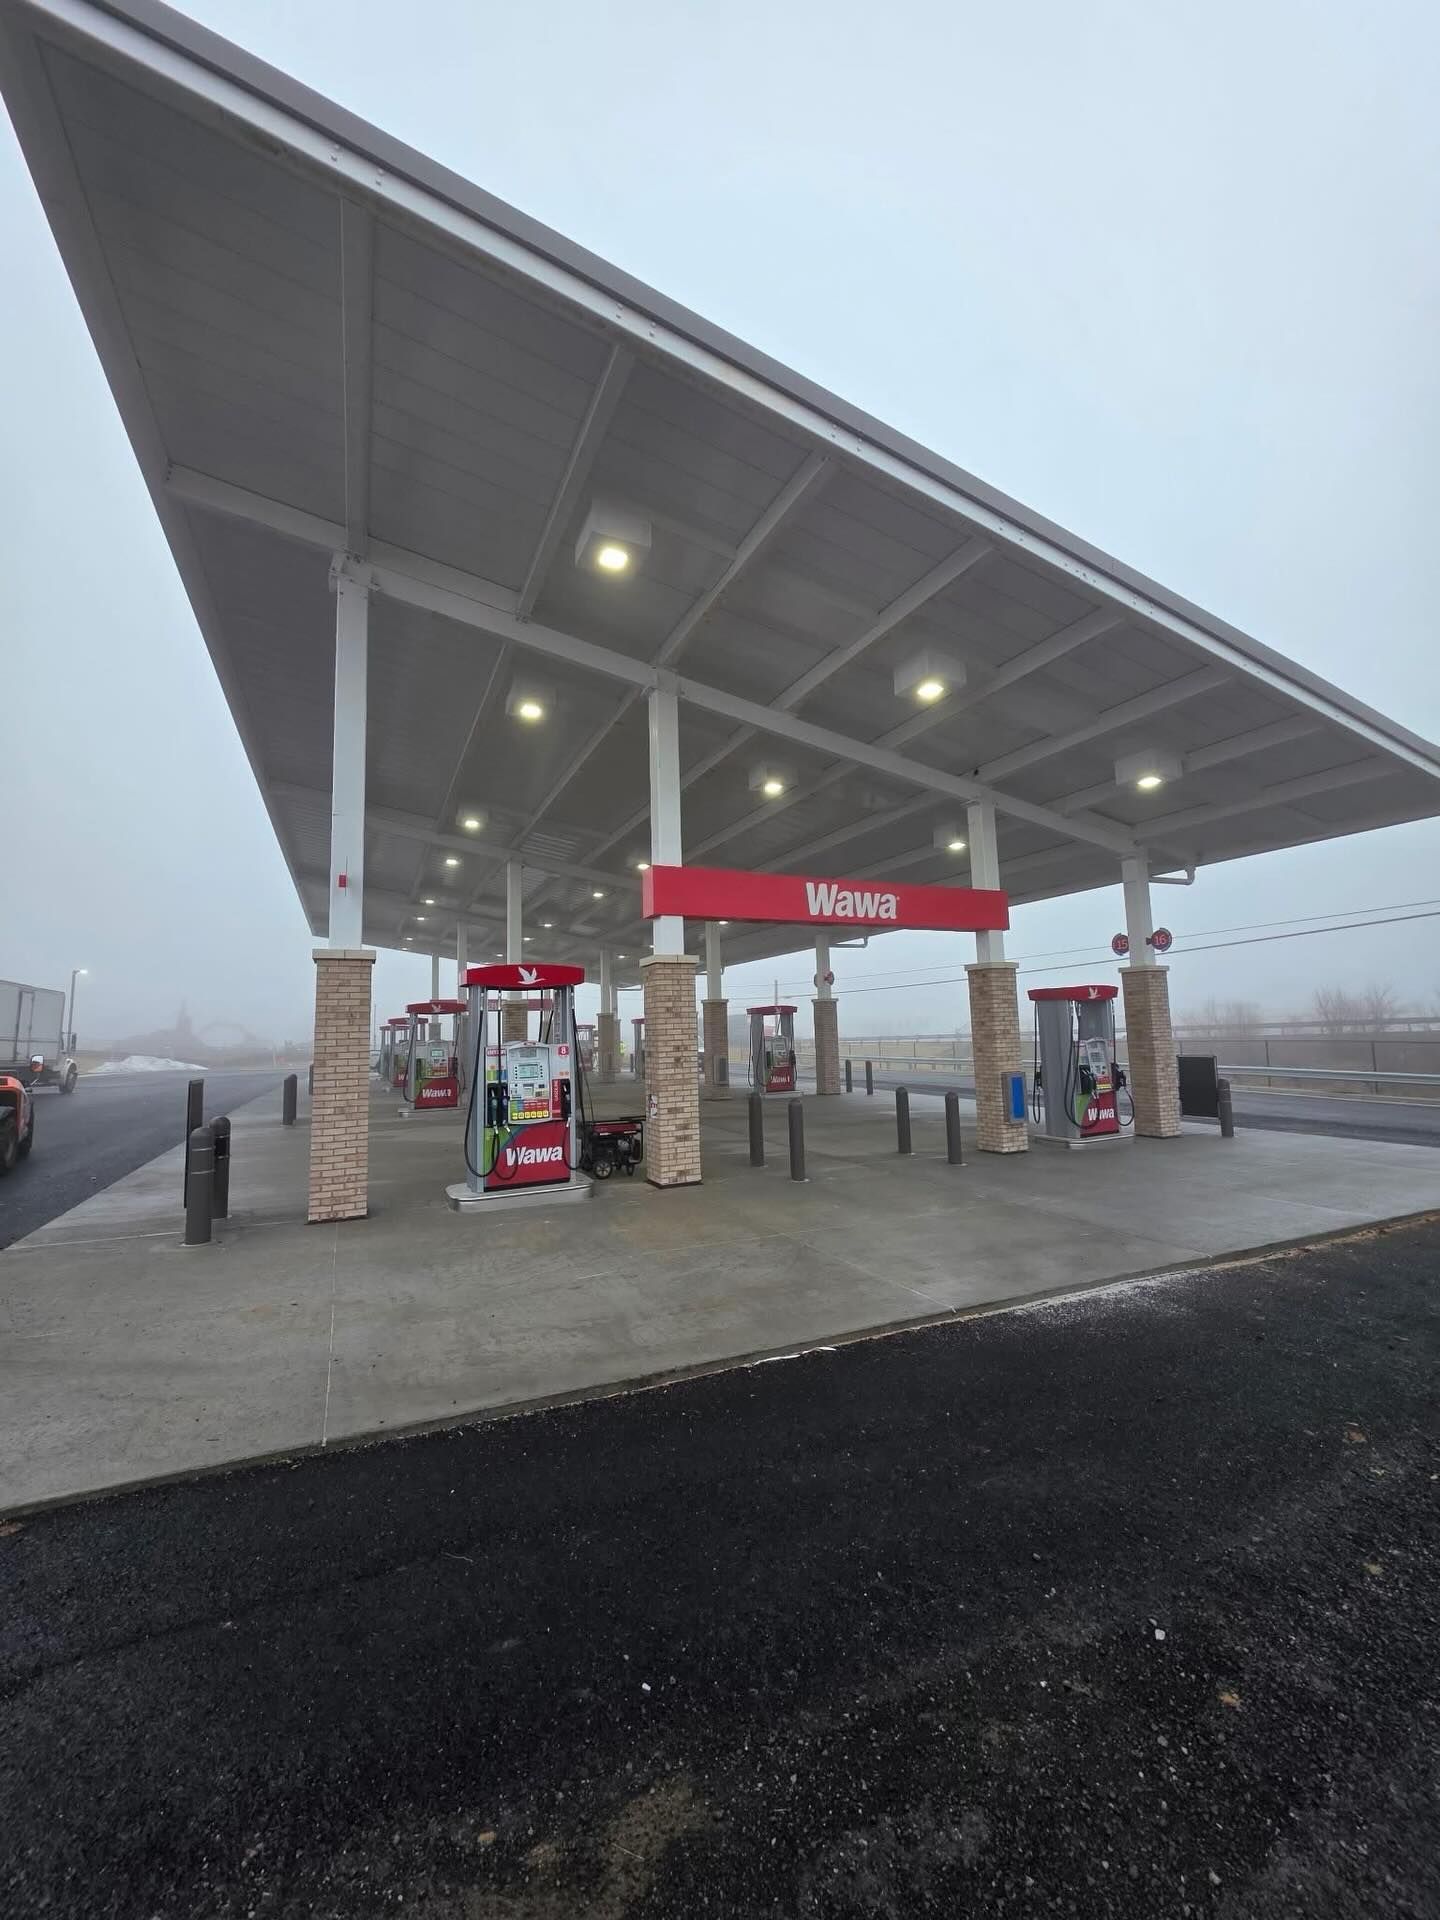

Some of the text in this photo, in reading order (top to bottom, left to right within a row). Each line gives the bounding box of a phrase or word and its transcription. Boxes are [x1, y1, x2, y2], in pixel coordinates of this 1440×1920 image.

[806, 882, 898, 919] Wawa
[1117, 940, 1128, 950] 15
[1154, 935, 1166, 946] 16
[561, 1046, 567, 1054] 8
[505, 1146, 563, 1167] Wawa
